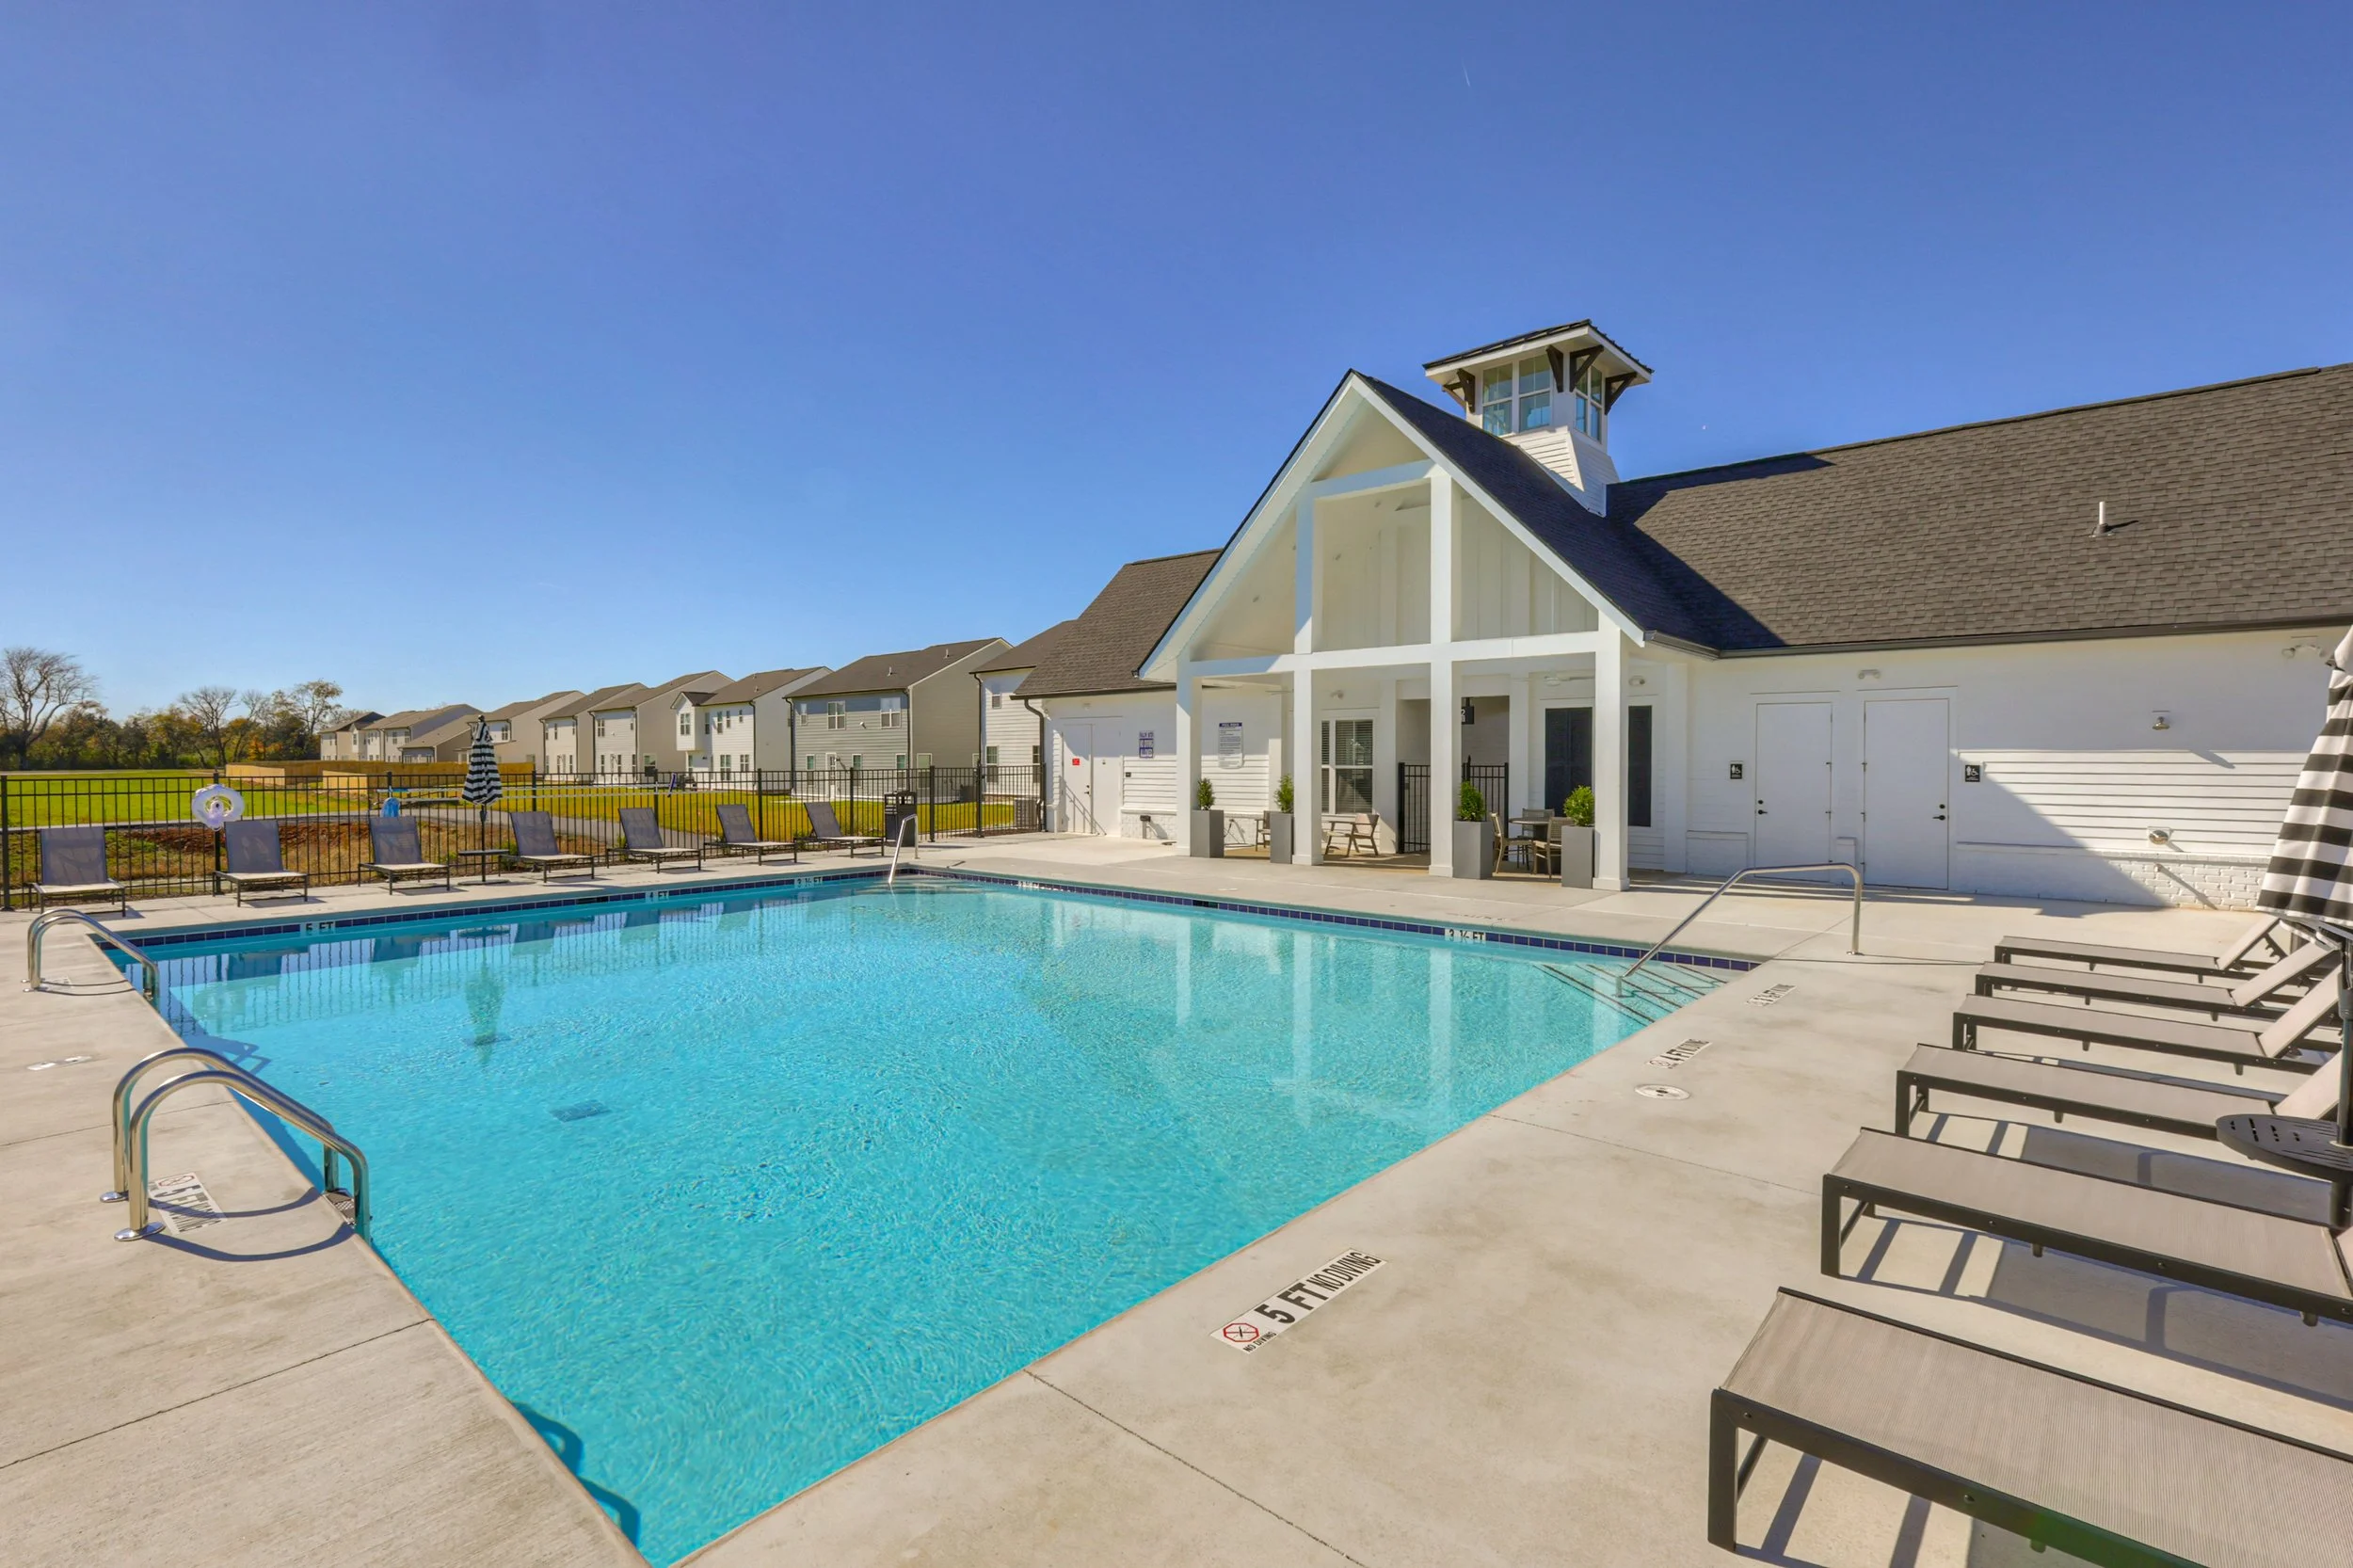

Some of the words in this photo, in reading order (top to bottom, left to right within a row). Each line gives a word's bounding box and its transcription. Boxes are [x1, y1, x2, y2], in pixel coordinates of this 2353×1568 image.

[319, 921, 334, 930] FT
[1472, 931, 1484, 940] FT
[1666, 1048, 1694, 1059] FT
[153, 1184, 201, 1198] 5
[1321, 1252, 1382, 1282] DIVING
[1305, 1273, 1345, 1292] NO
[1276, 1282, 1329, 1311] FT
[1254, 1304, 1296, 1324] 5
[1242, 1344, 1257, 1352] NO
[1253, 1332, 1276, 1346] DIVING
